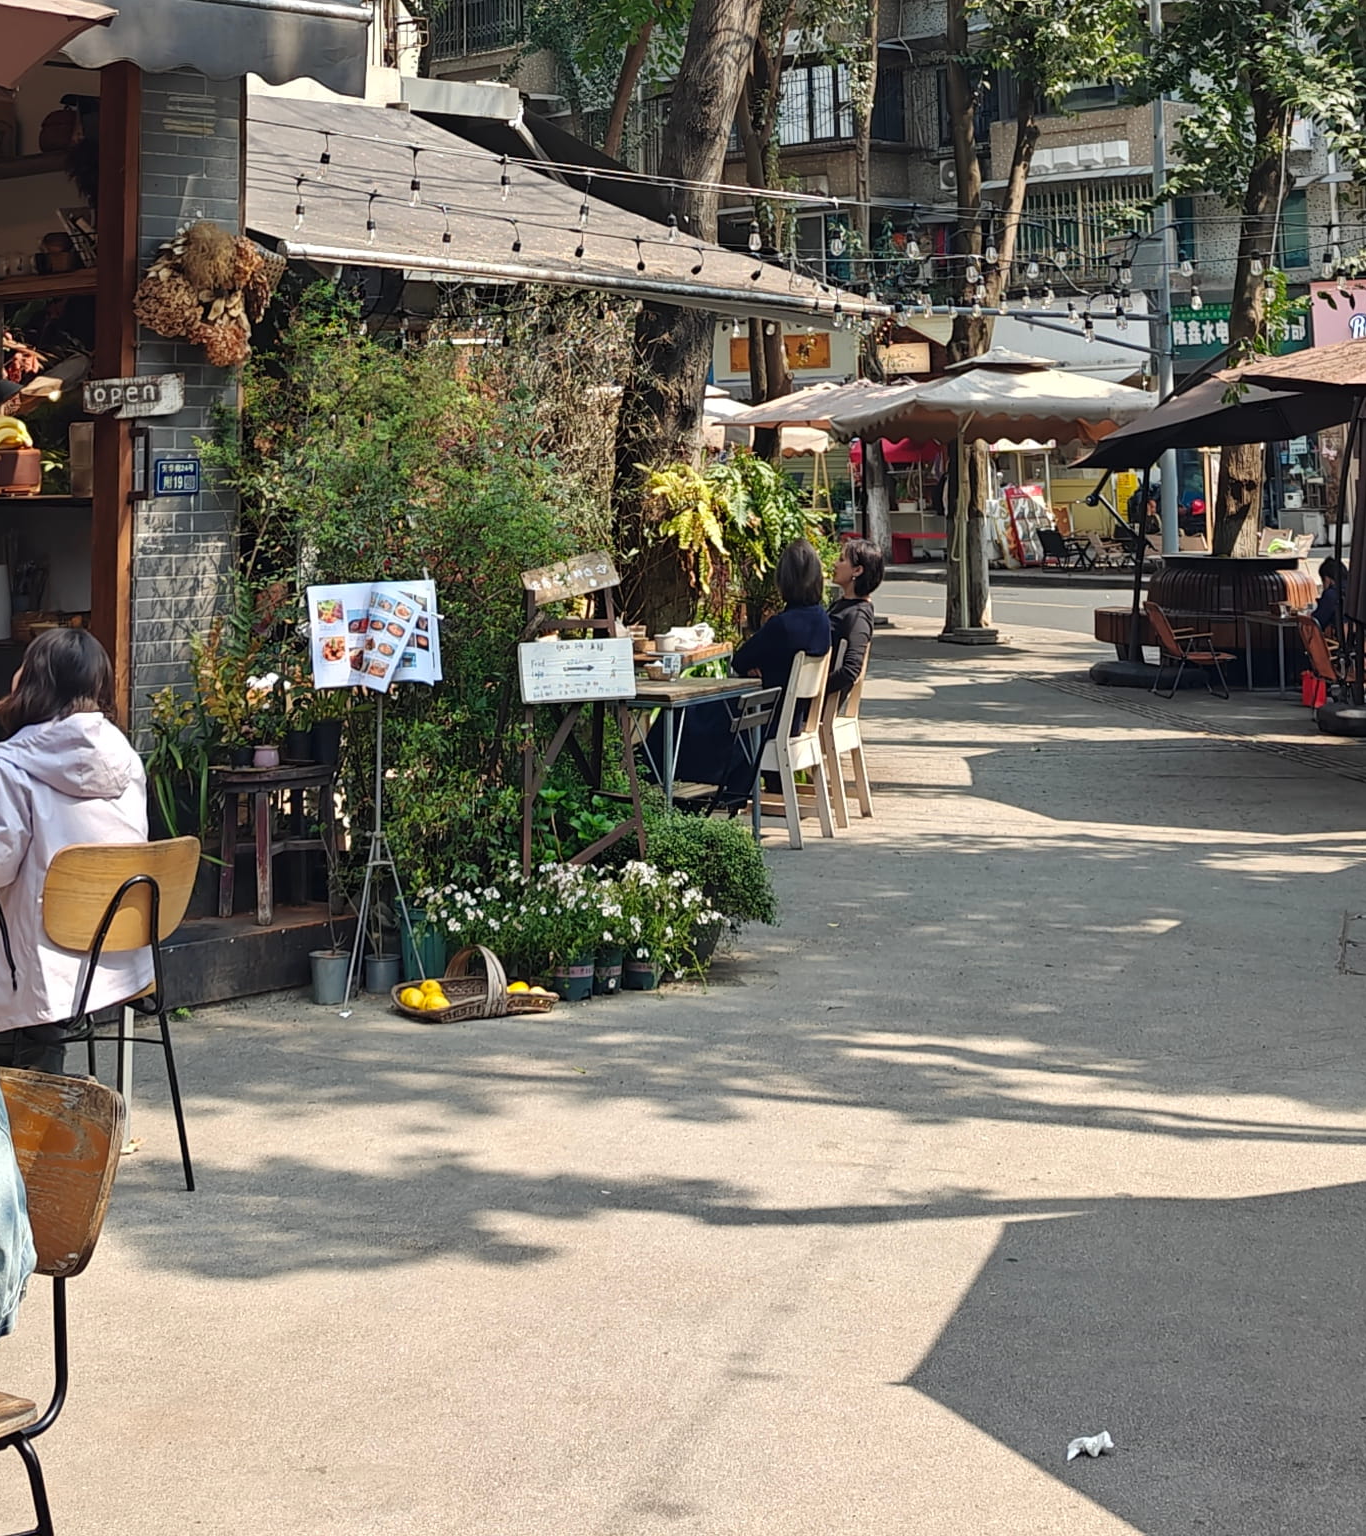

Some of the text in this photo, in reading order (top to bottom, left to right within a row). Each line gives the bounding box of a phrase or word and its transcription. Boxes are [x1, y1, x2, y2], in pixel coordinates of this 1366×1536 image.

[1172, 319, 1230, 345] 隆鑫水电
[93, 384, 155, 405] open
